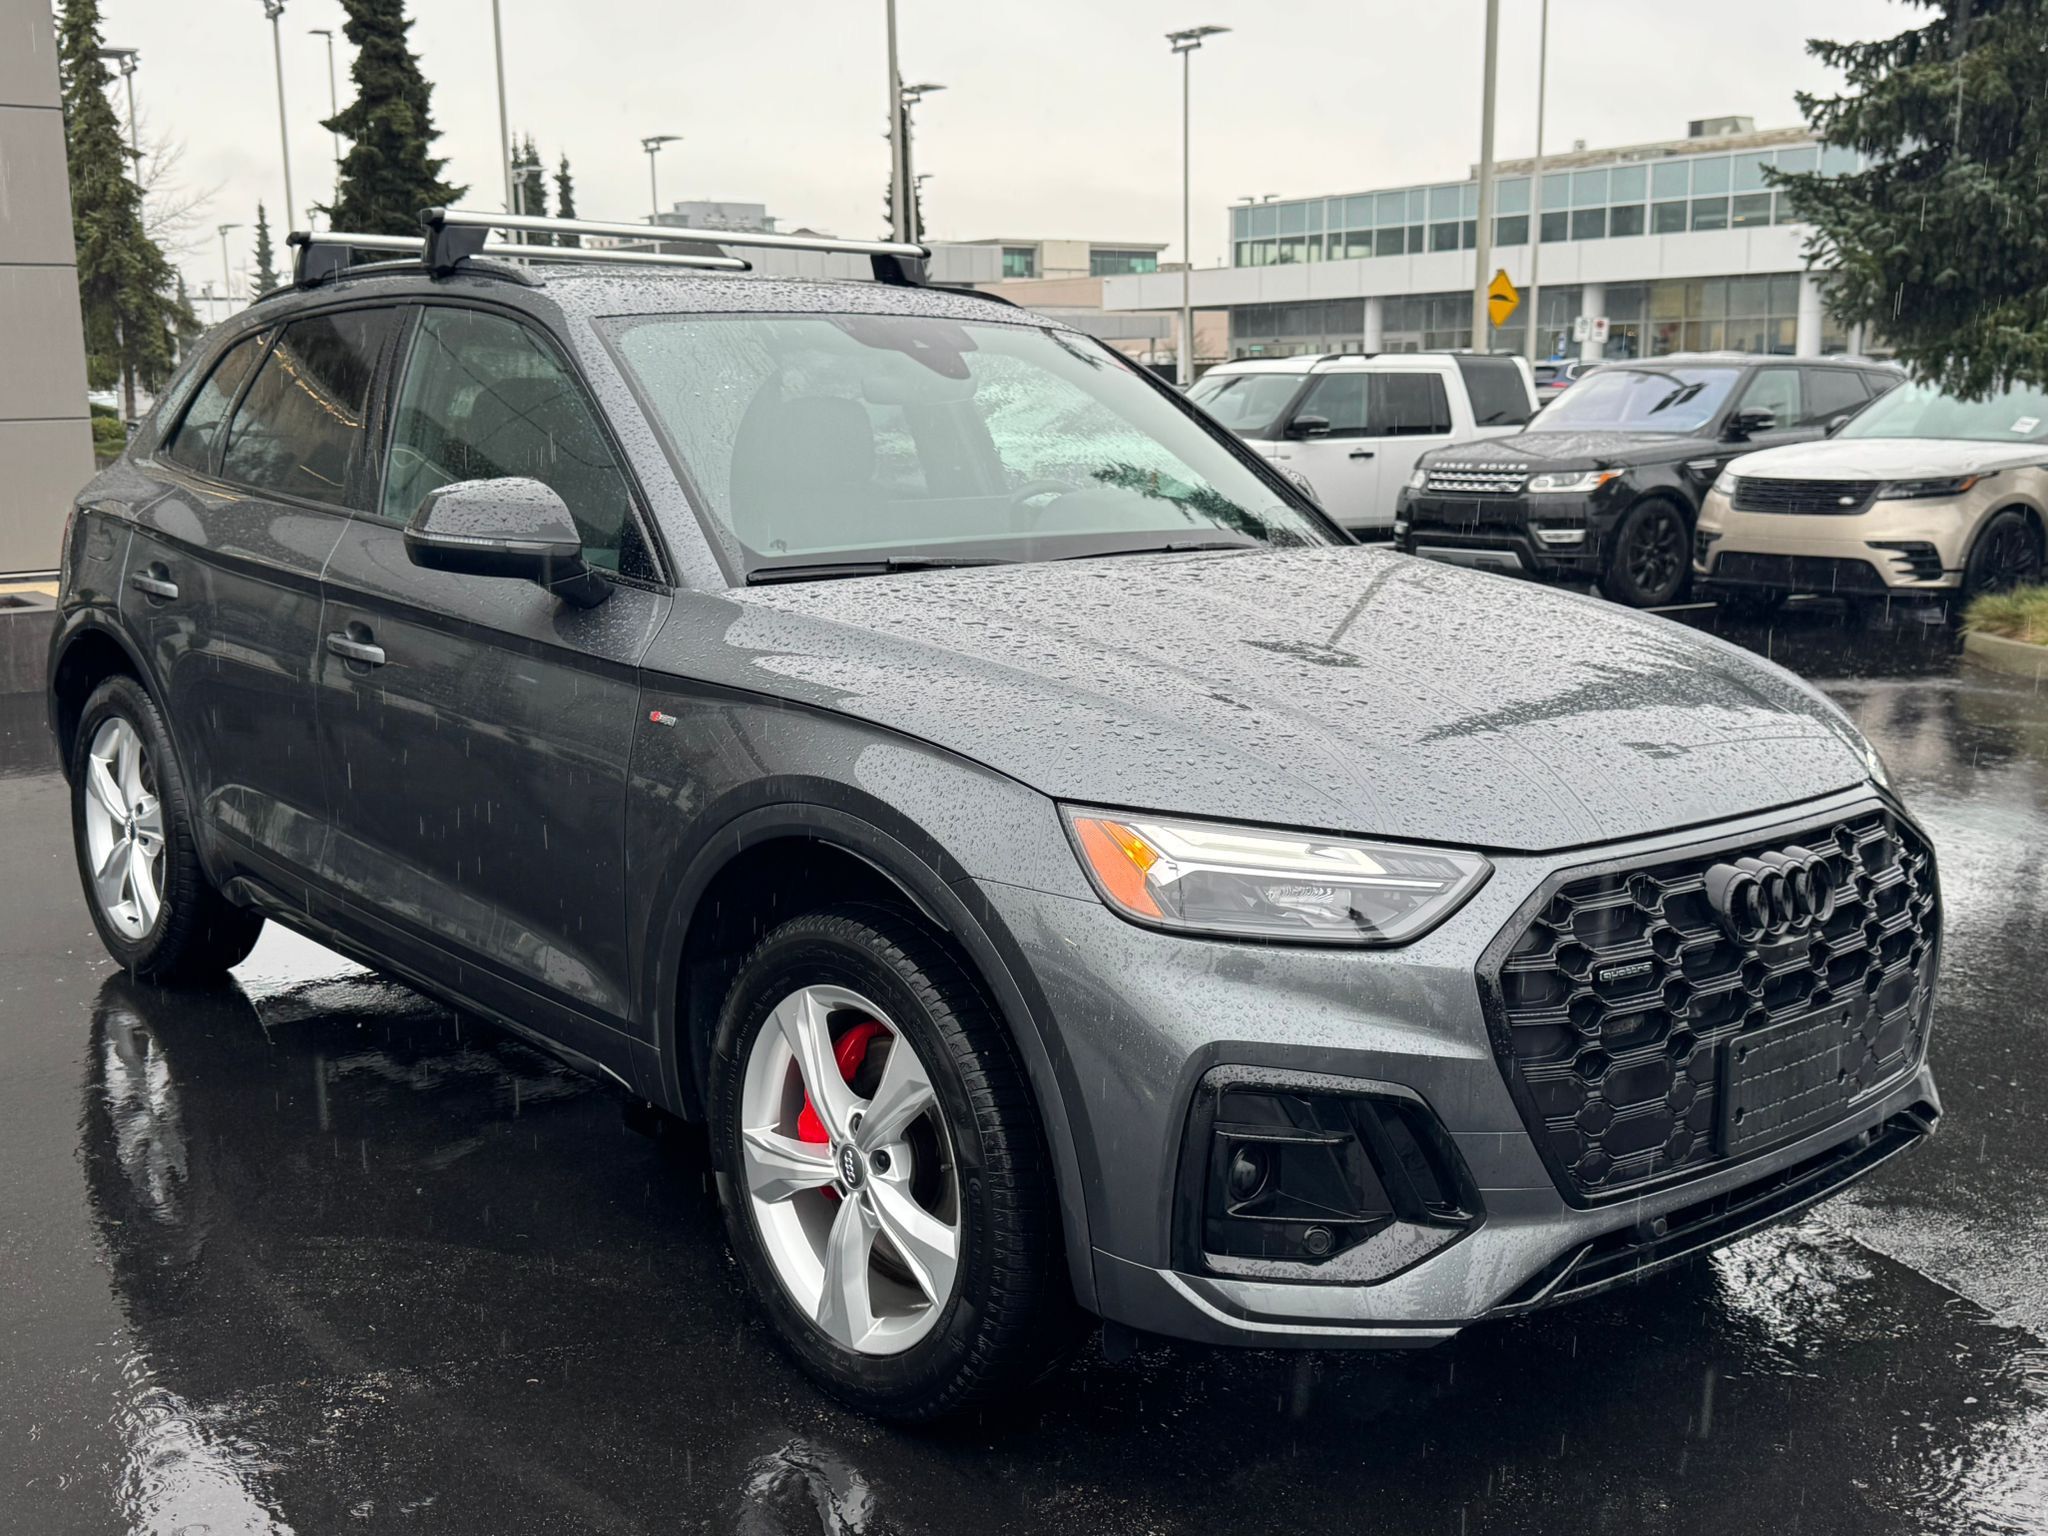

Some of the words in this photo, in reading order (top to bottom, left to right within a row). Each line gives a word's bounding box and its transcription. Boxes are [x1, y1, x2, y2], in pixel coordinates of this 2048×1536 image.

[1434, 462, 1473, 470] RANGE
[1479, 463, 1528, 471] ROVER
[1602, 963, 1651, 980] quattro
